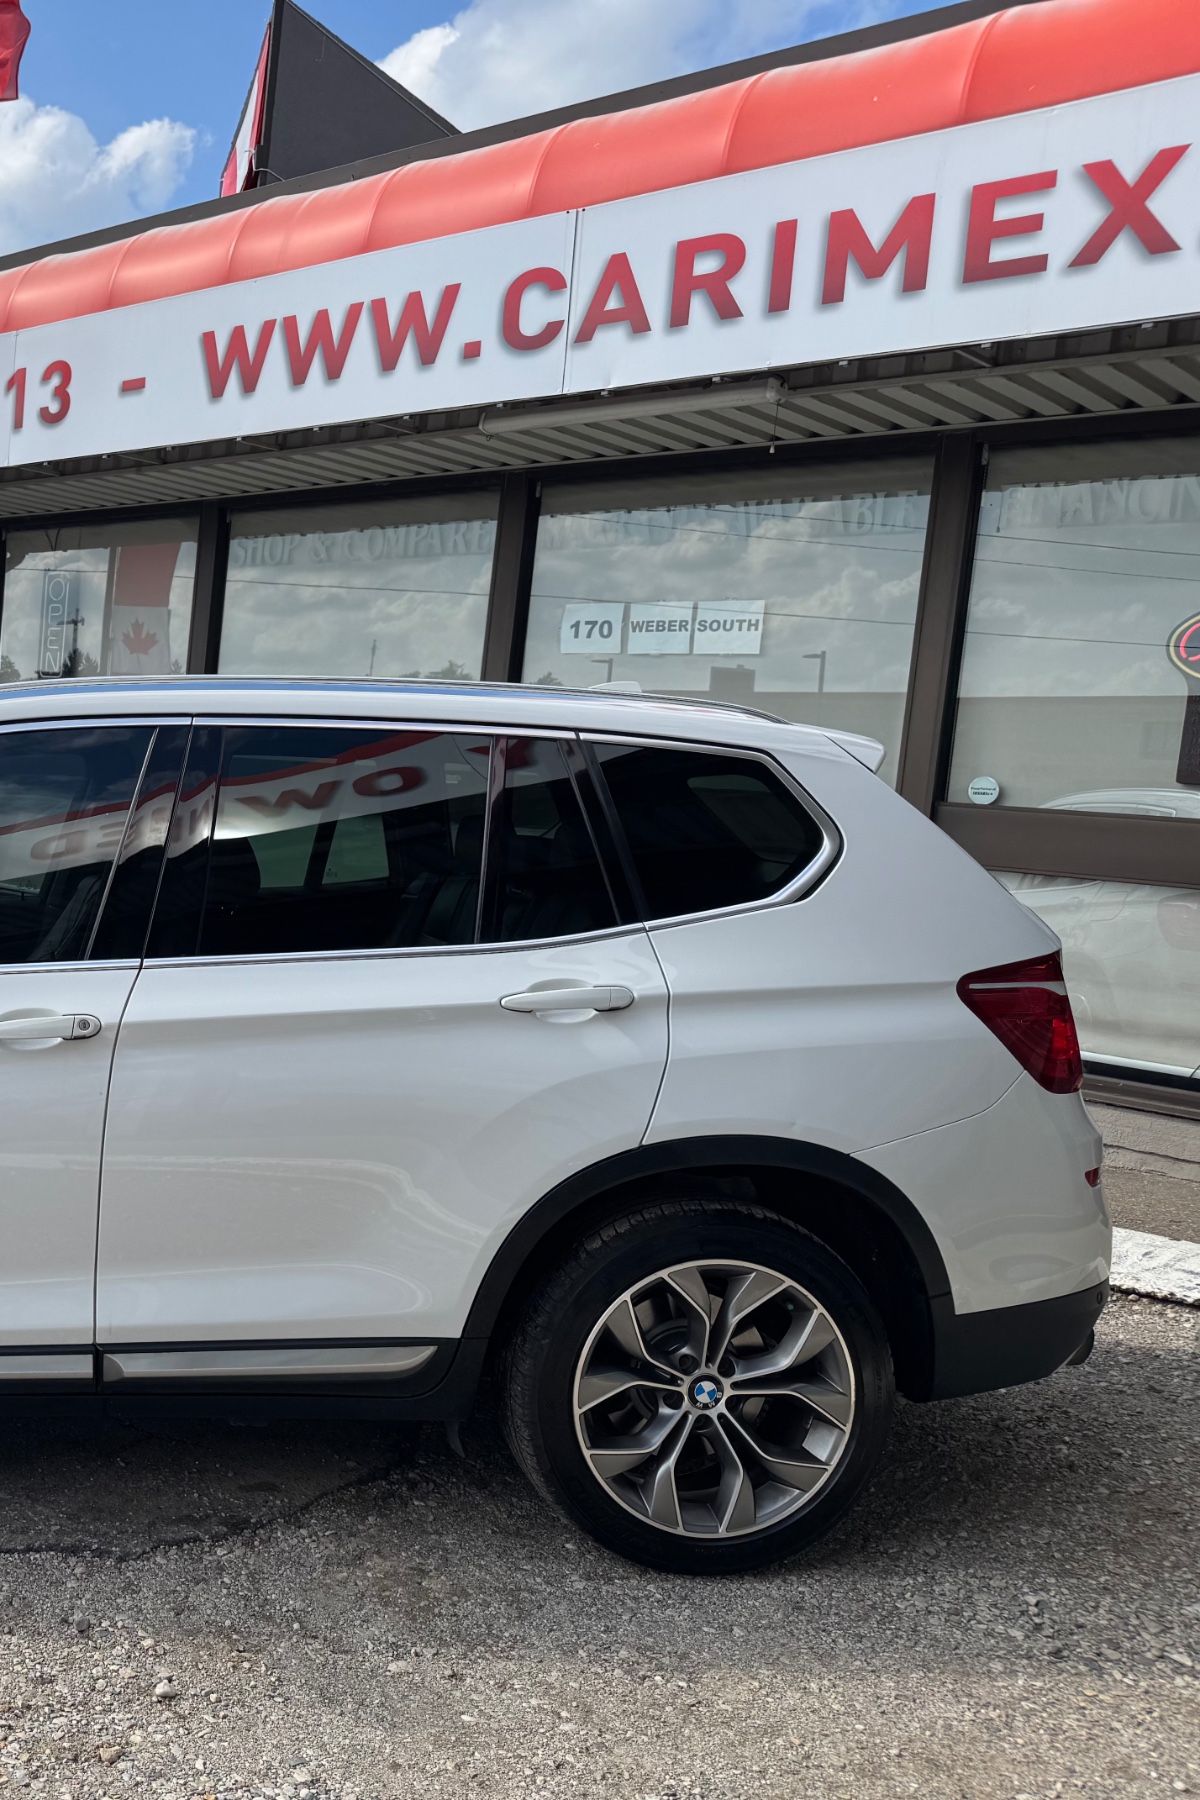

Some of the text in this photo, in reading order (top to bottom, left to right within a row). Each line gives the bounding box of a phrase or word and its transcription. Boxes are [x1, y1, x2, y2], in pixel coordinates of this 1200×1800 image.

[202, 142, 1193, 399] WWW.CARIMEX
[46, 578, 65, 672] OPEN
[569, 619, 613, 640] 170
[631, 619, 689, 633] WEBER
[697, 618, 760, 633] SOUTH
